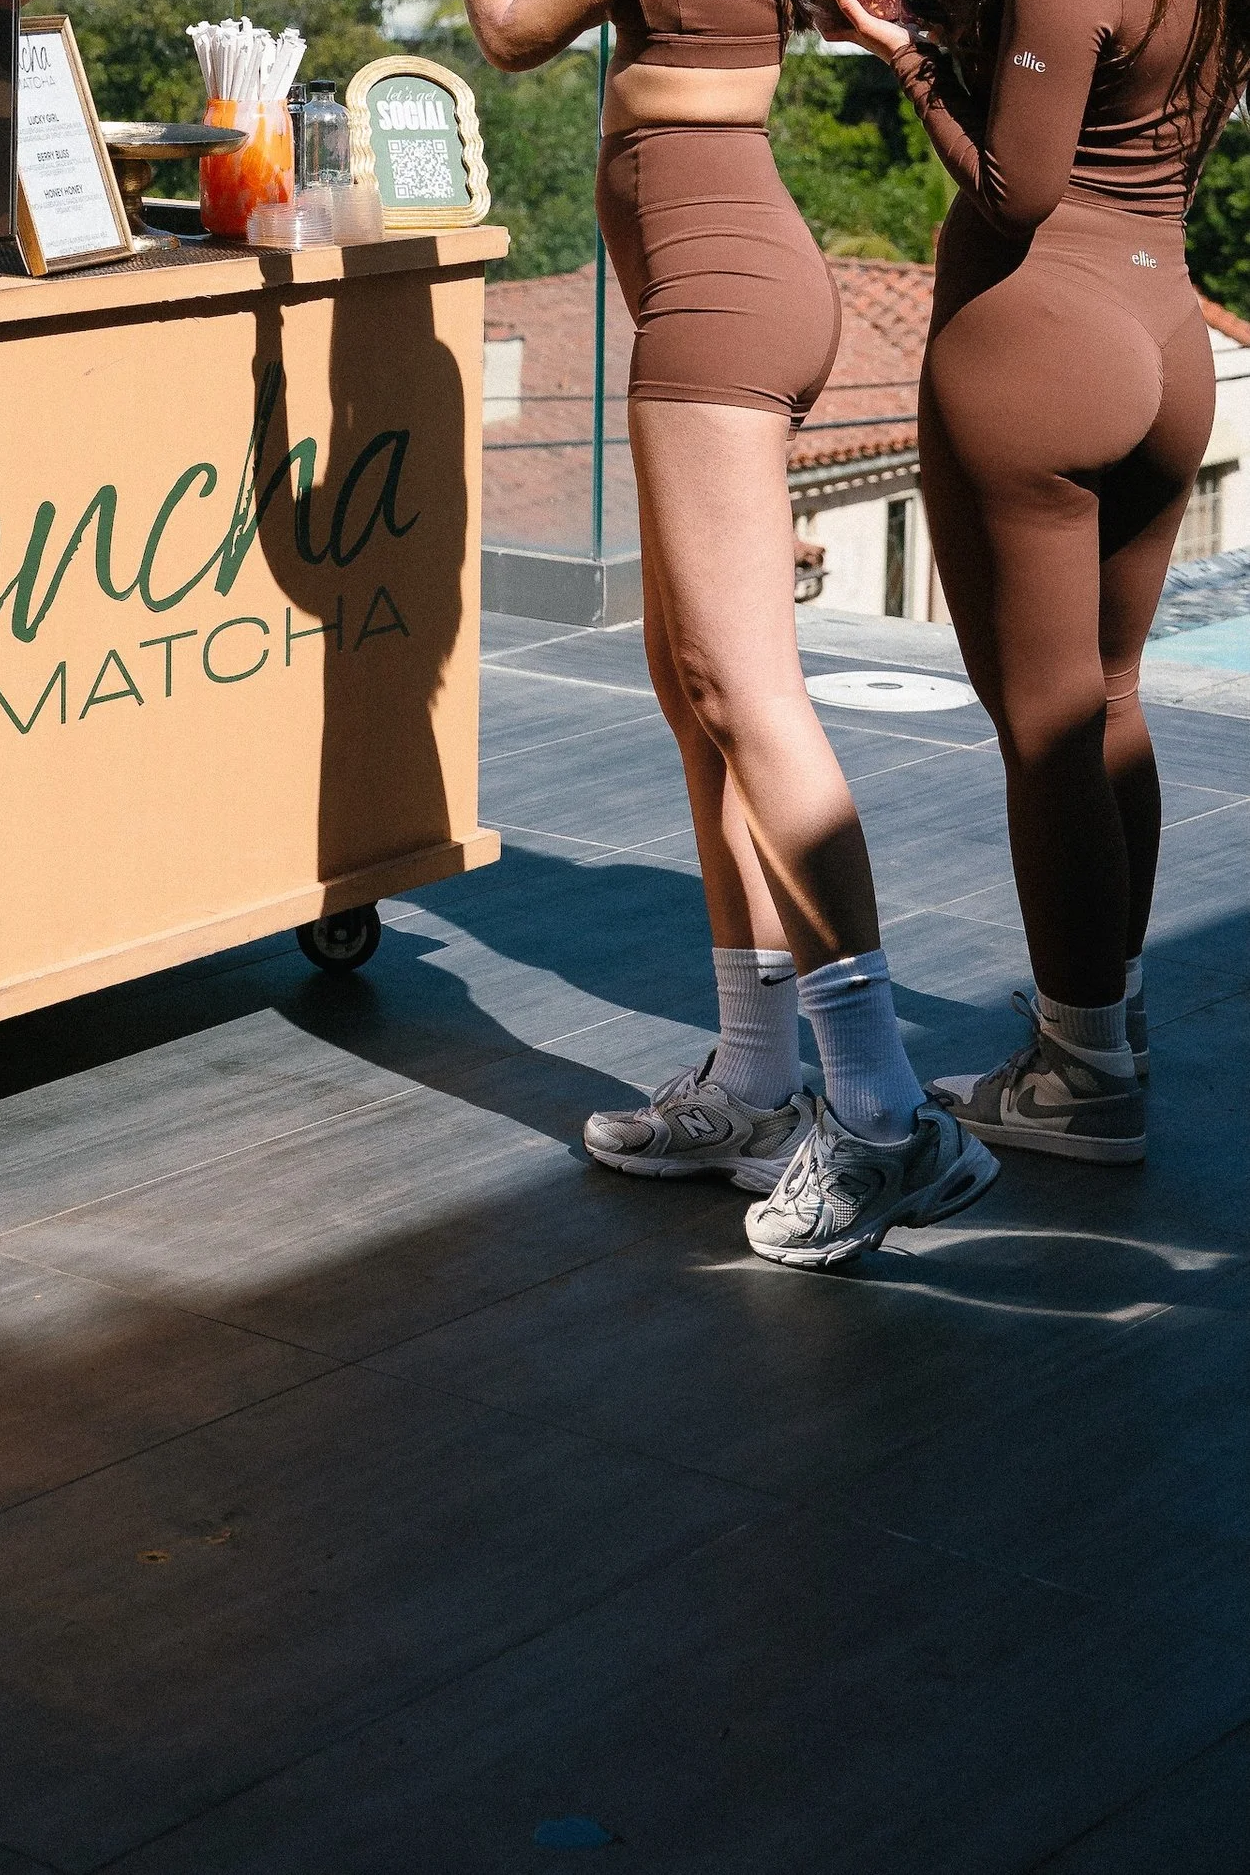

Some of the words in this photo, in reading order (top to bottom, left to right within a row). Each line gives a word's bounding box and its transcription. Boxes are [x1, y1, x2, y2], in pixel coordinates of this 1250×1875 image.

[18, 35, 51, 73] cha
[1013, 51, 1046, 73] ellie
[19, 76, 56, 90] ATCHA
[27, 115, 46, 126] LUCKY
[45, 113, 60, 123] GIRL
[376, 100, 450, 131] SOCIAL
[36, 151, 55, 162] BERRY
[54, 149, 70, 160] BLISS
[43, 187, 63, 199] HONEY
[63, 185, 84, 196] HONEY
[1131, 250, 1158, 269] ellie
[677, 1107, 717, 1139] N
